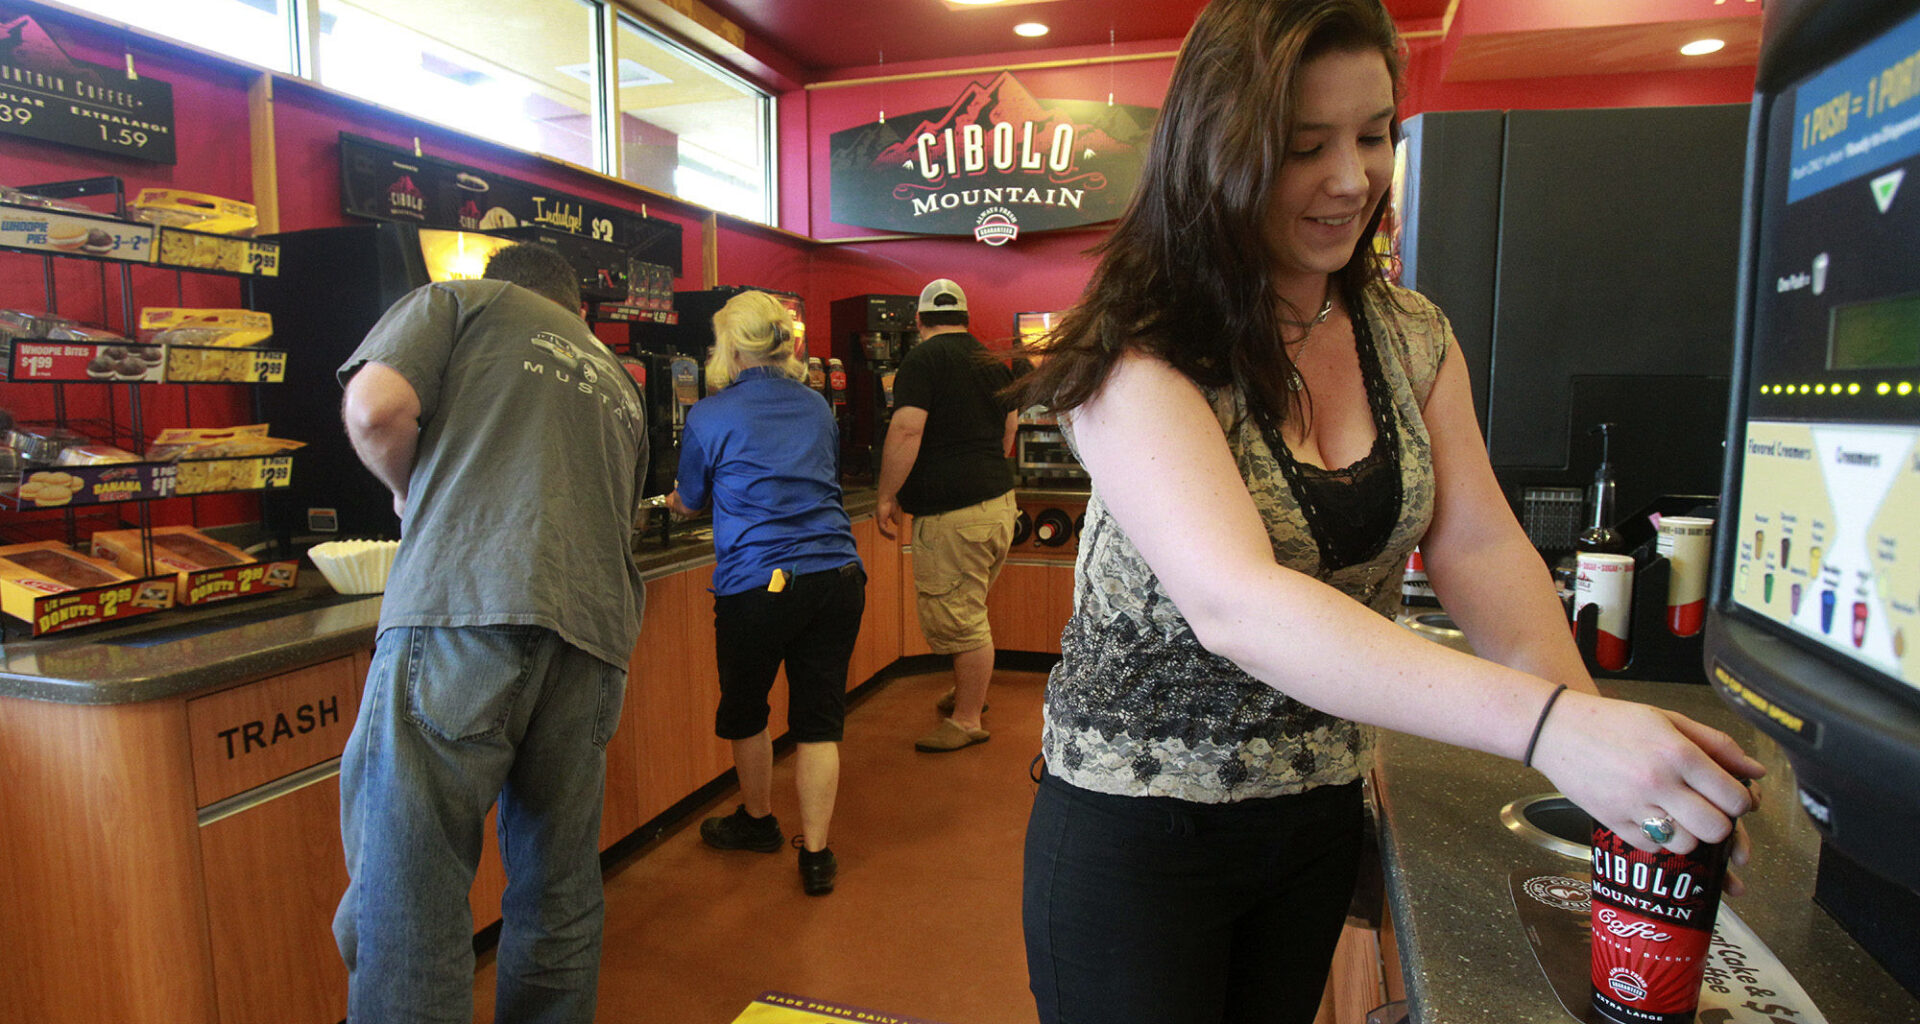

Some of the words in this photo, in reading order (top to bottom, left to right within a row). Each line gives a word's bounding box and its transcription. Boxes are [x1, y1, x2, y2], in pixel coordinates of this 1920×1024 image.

[75, 80, 134, 108] COFFEE
[98, 124, 149, 148] 1.59
[1802, 112, 1811, 150] 1
[1811, 90, 1851, 146] PUSH
[917, 121, 1075, 180] CIBOLO
[532, 196, 583, 234] Indulge!
[912, 187, 1084, 217] MOUNTAIN
[21, 345, 63, 356] WHOOPIE
[64, 346, 90, 357] BITES
[21, 356, 53, 376] $199
[523, 360, 633, 430] MUSTA
[93, 481, 142, 495] BANANA
[190, 580, 236, 604] DONUTS
[237, 567, 264, 592] $299
[39, 604, 97, 633] DONUTS
[99, 588, 132, 617] $299
[217, 696, 339, 760] TRASH
[1594, 846, 1692, 899] CIBOLO
[1592, 880, 1693, 920] MOUNTAIN
[1598, 908, 1672, 942] Coffee
[1643, 952, 1691, 962] BLEND
[1717, 949, 1760, 984] Cake
[1744, 985, 1777, 997] &
[766, 995, 803, 1008] MADE
[808, 1002, 853, 1016] FRESH
[857, 1011, 898, 1024] DAILY
[1596, 992, 1623, 1012] EXTRA
[1626, 1008, 1663, 1022] LARGE
